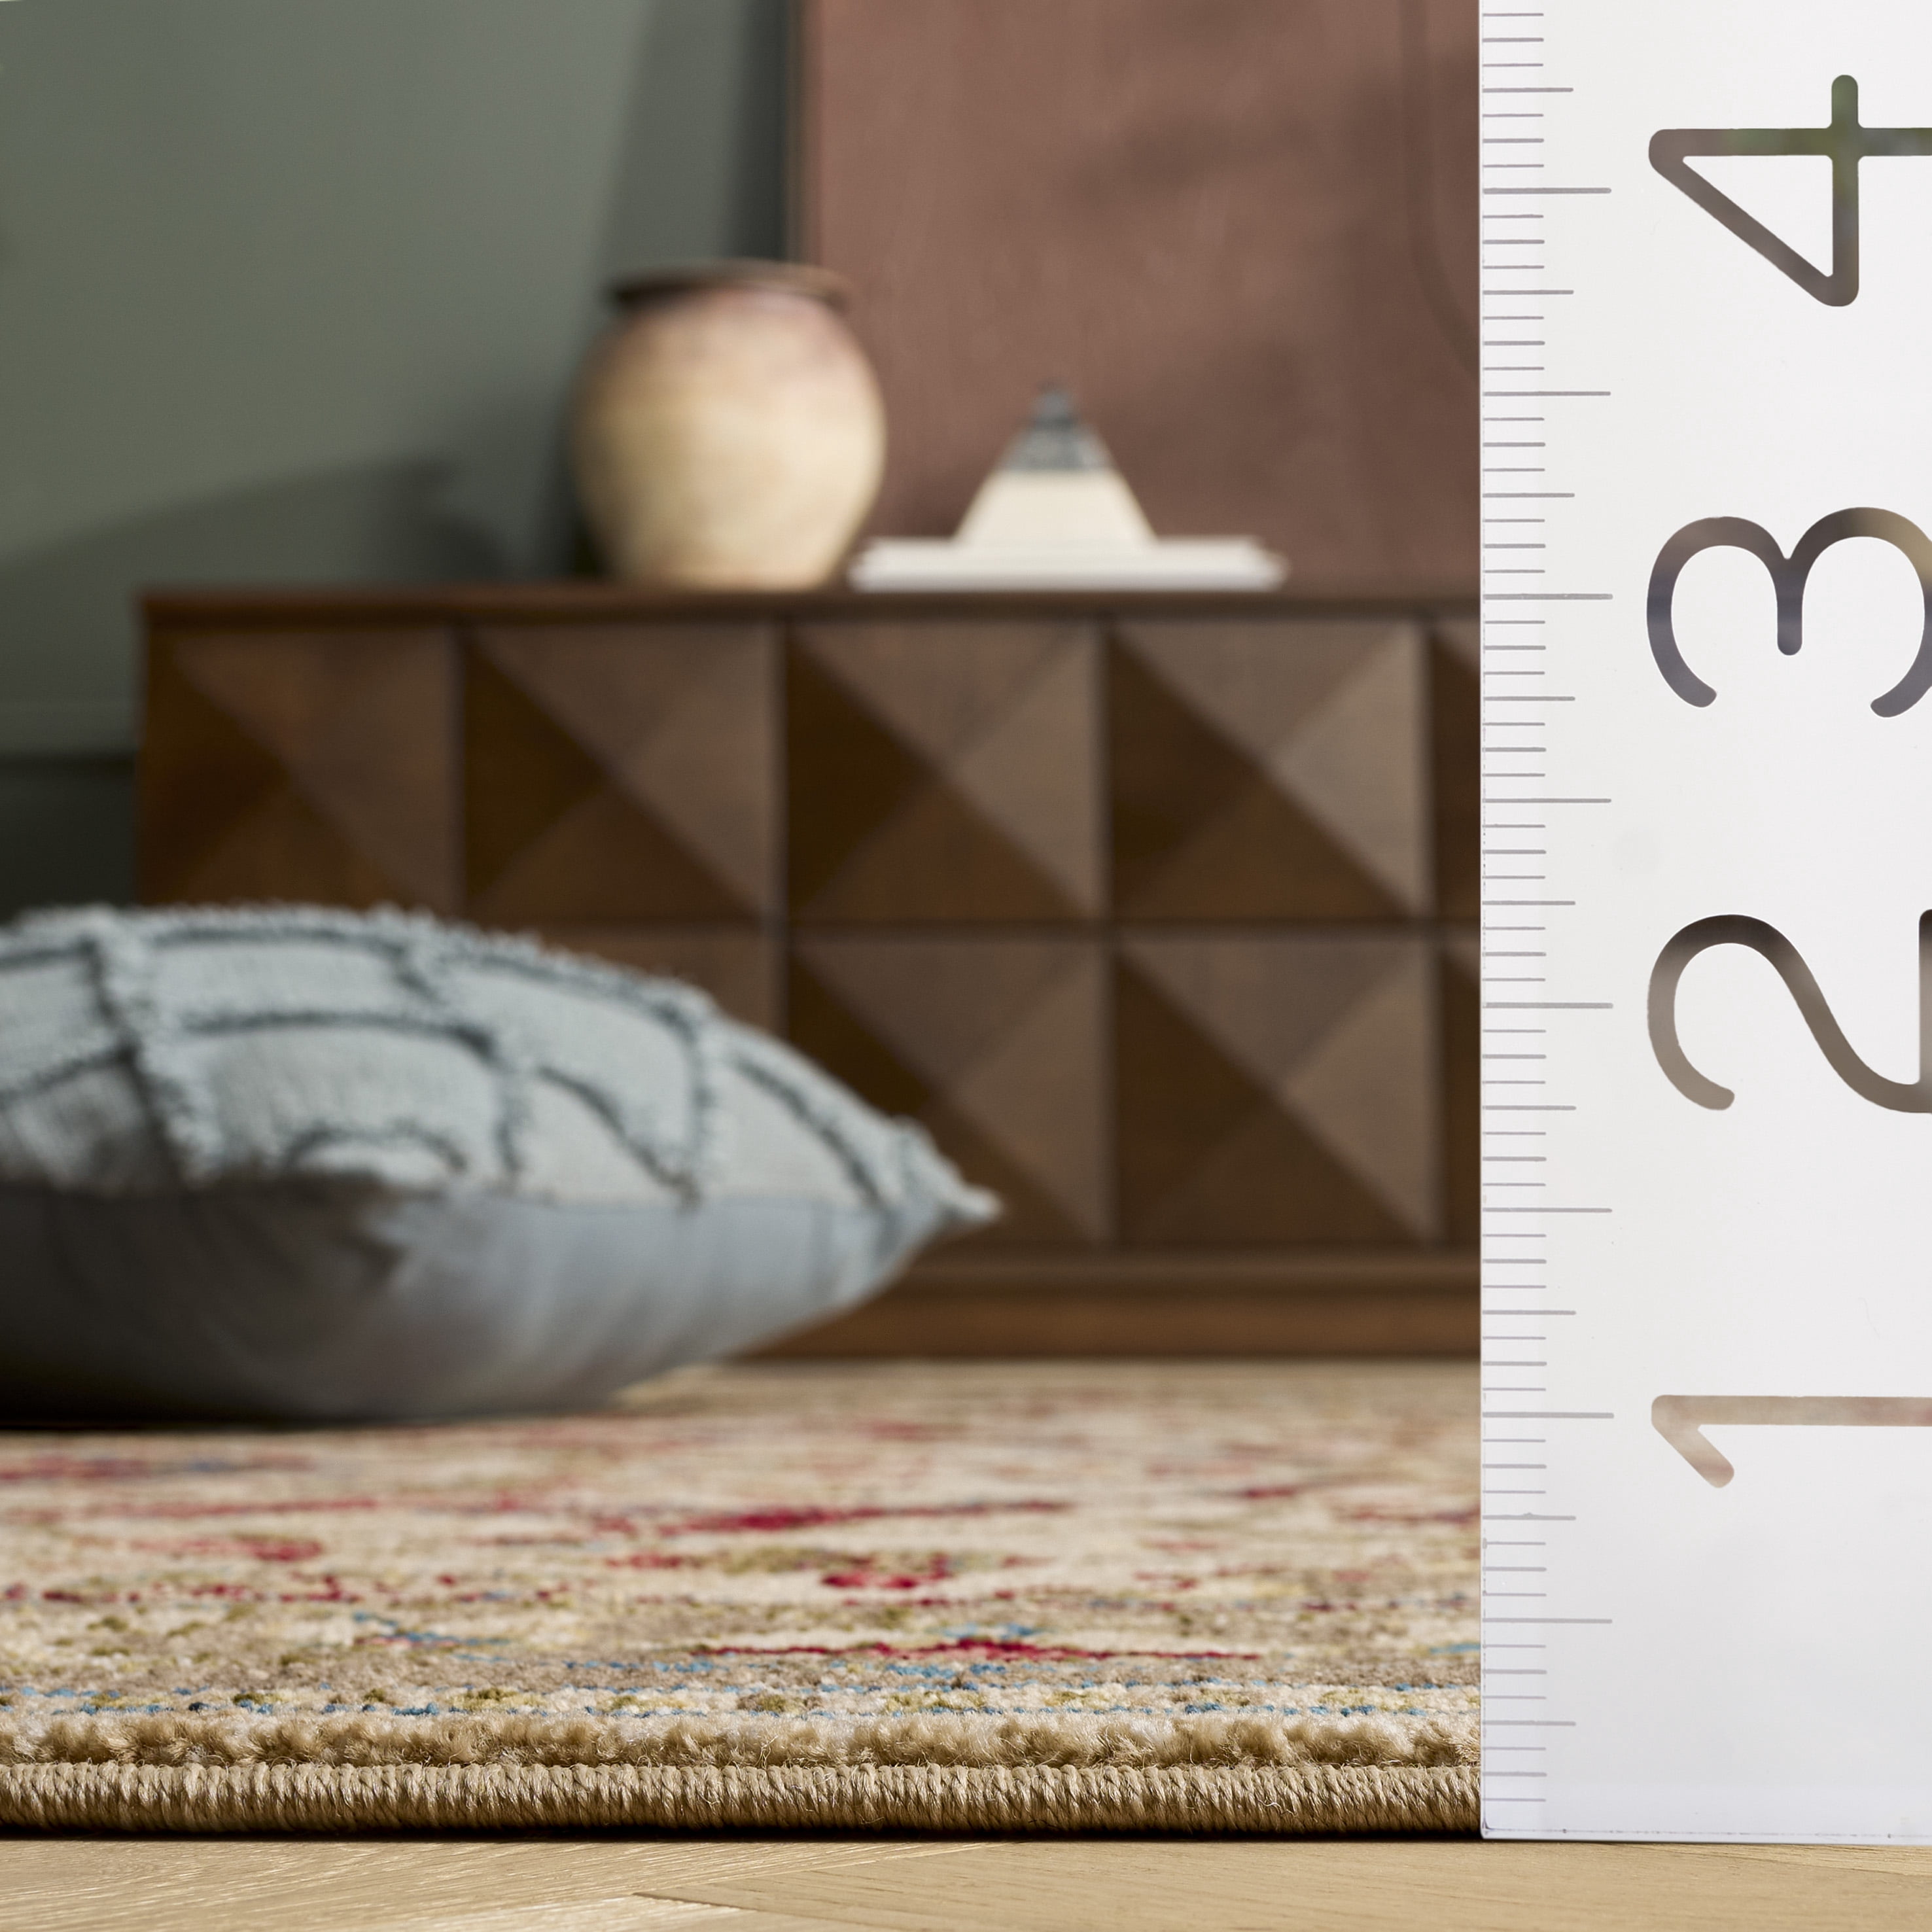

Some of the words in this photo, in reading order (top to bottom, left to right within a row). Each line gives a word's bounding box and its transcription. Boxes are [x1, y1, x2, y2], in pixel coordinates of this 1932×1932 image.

[1648, 75, 1932, 307] 4
[1646, 507, 1932, 718] 3
[1647, 909, 1932, 1115] 2
[1651, 1394, 1932, 1488] 1
